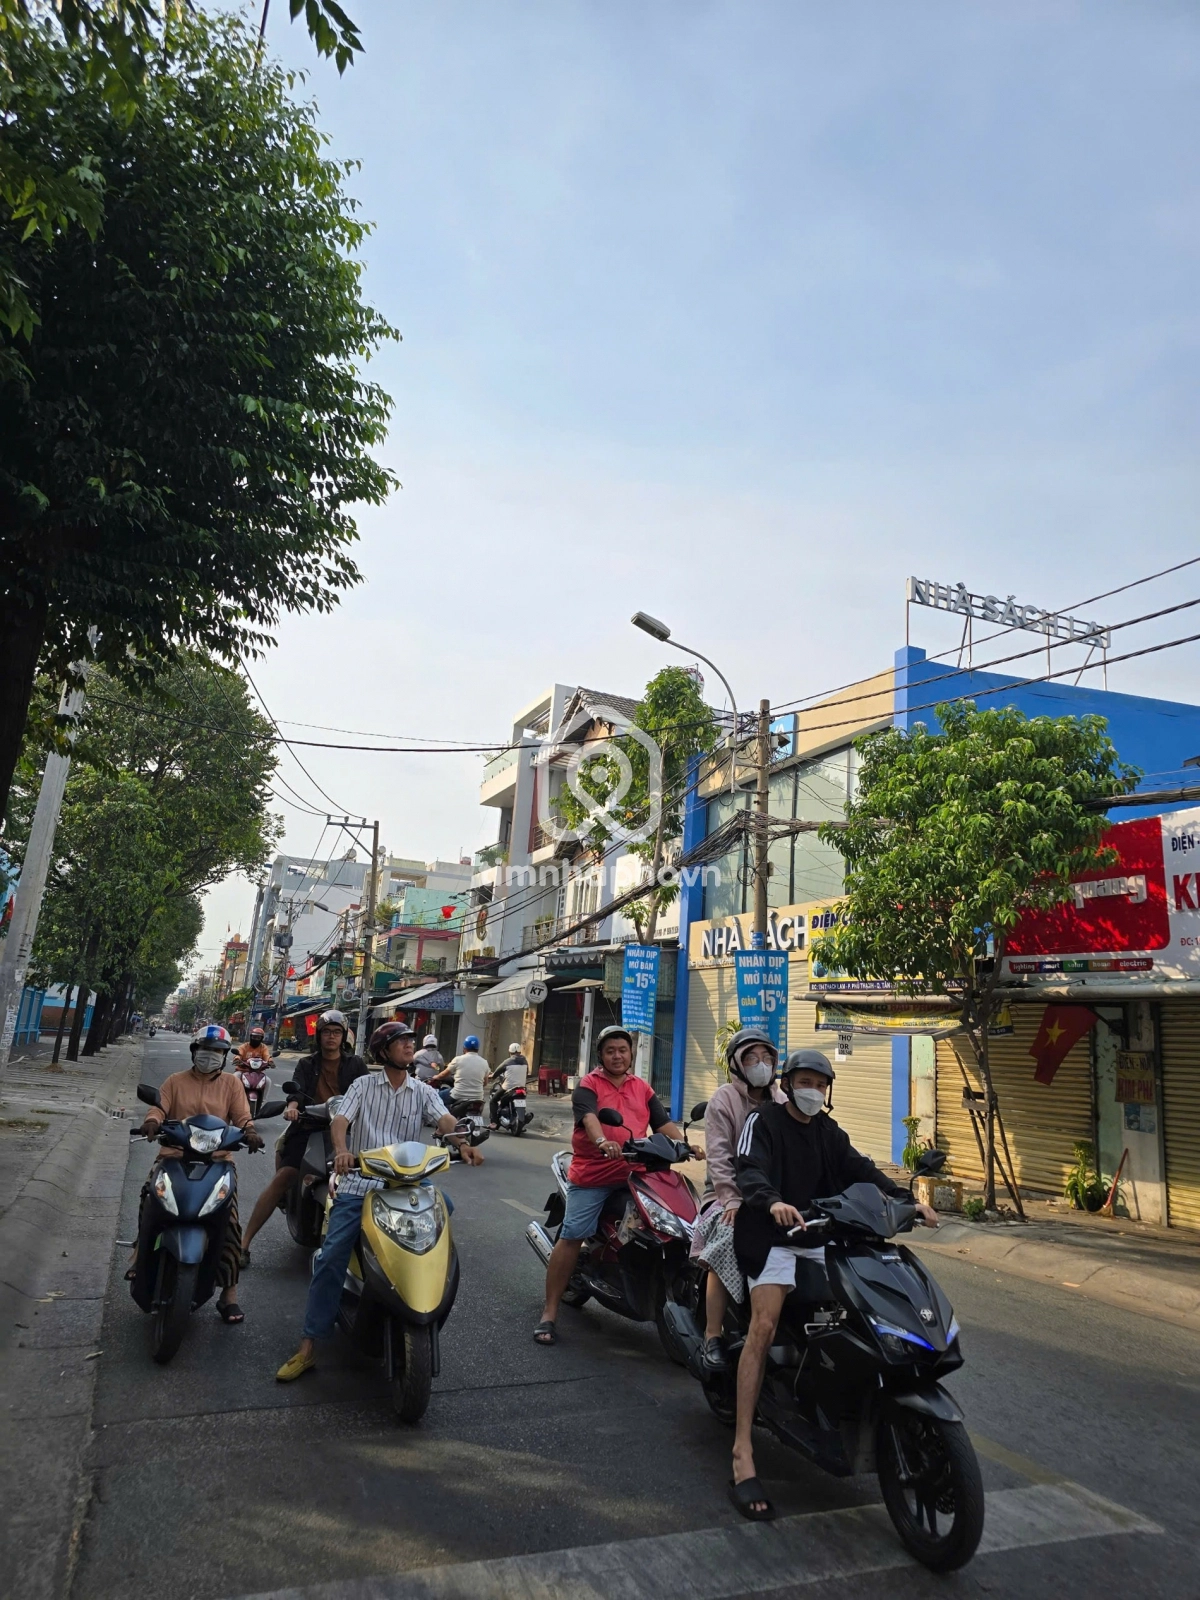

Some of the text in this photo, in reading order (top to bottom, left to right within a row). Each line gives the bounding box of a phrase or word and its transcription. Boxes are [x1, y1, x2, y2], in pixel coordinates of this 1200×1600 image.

[907, 576, 974, 616] NHÀ
[982, 595, 1059, 637] SÁCH
[1171, 832, 1194, 854] ĐIỆN
[701, 916, 743, 957] NHÀ
[646, 950, 658, 960] DỊP
[739, 954, 766, 968] NHÂN
[768, 956, 785, 970] DỊP
[640, 961, 654, 971] BÁN
[1013, 963, 1036, 972] lighting
[1092, 960, 1112, 968] home
[1119, 959, 1148, 968] electric
[635, 972, 656, 988] 15%
[743, 969, 782, 985] MỞ BÁN
[530, 986, 544, 996] KT
[758, 989, 786, 1012] 15%
